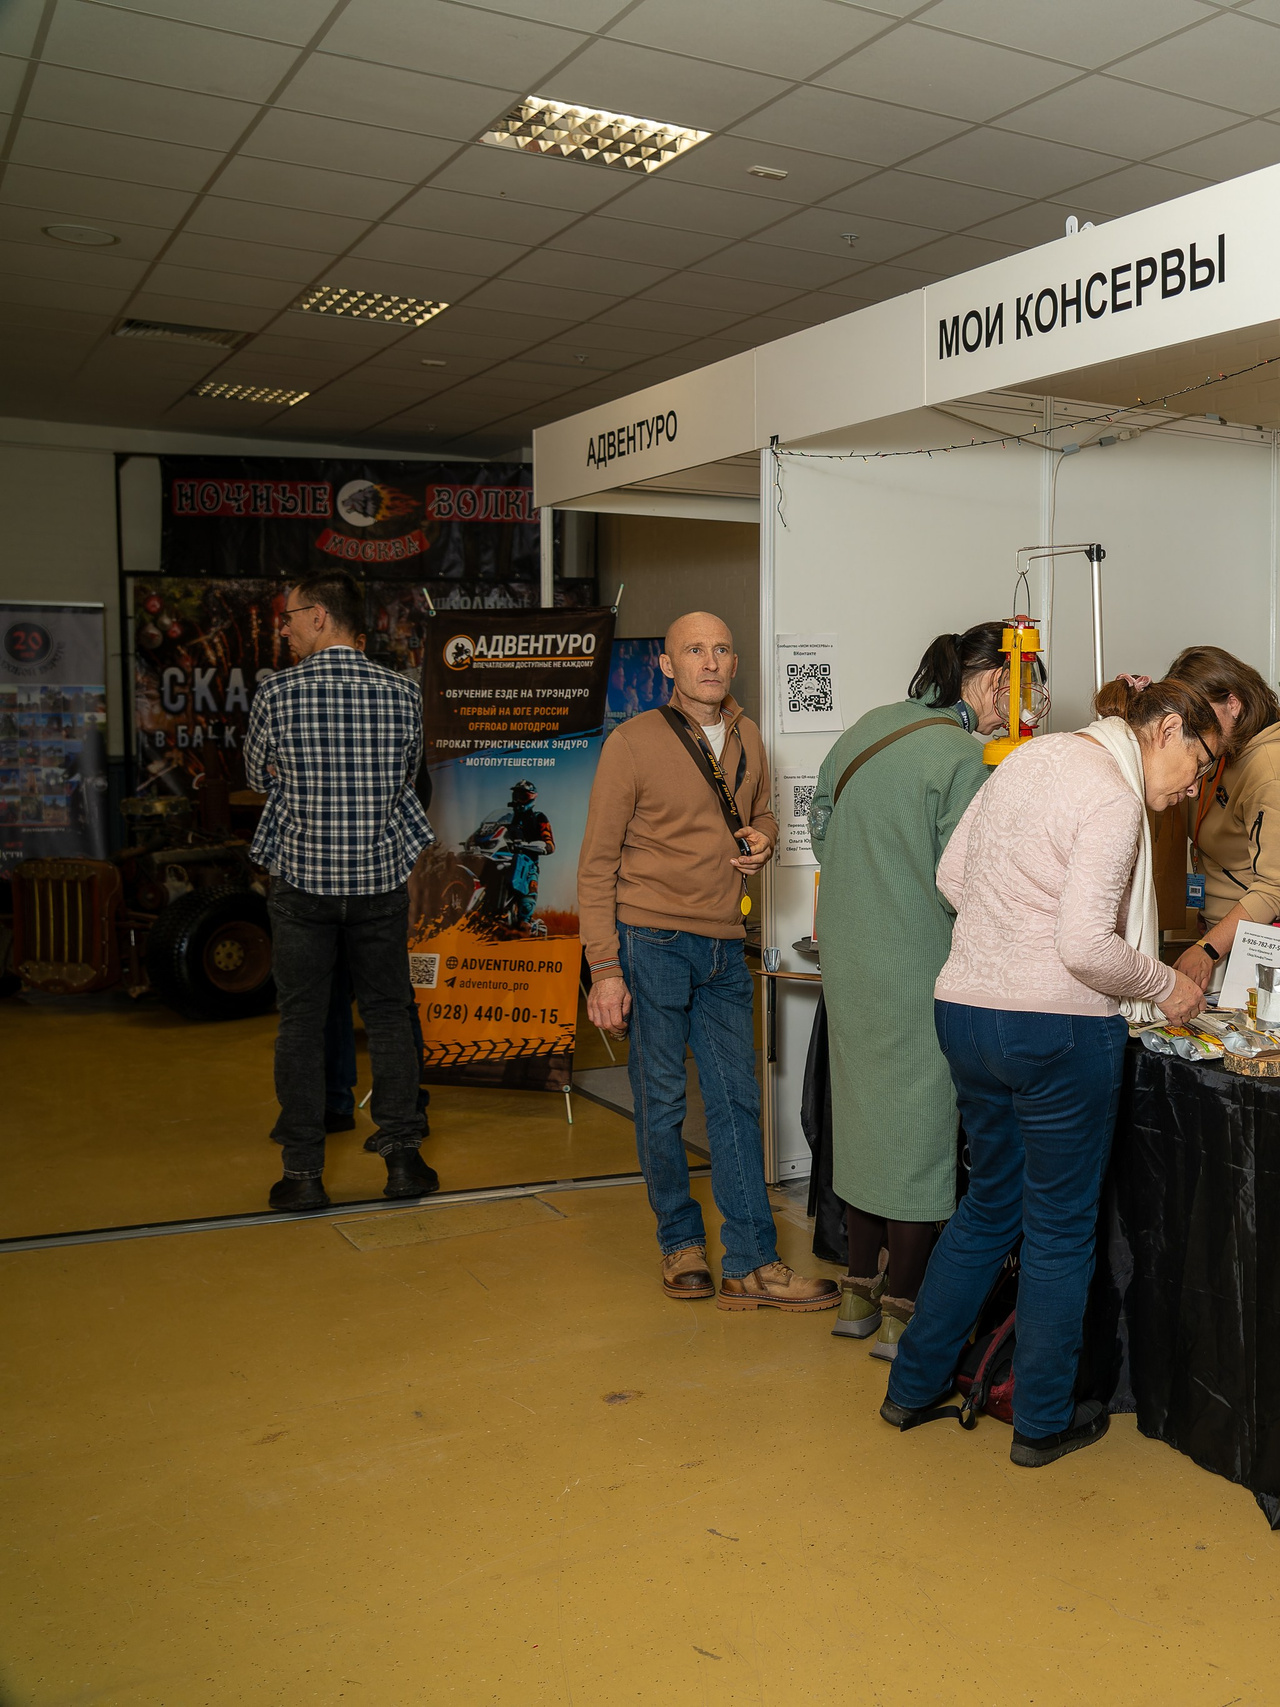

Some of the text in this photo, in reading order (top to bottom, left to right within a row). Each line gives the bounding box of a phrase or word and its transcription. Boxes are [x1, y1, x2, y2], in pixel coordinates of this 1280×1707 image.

[939, 233, 1226, 360] МОИ КОНСЕРВЫ
[587, 410, 678, 470] АДВЕНТУРО
[175, 480, 333, 516] НОЧНЫЕ
[325, 533, 422, 562] МОСКВА
[12, 631, 43, 651] 20
[475, 633, 596, 659] АДВЕНТУРО
[473, 660, 595, 670] ВПЕЧАТЛЕНИЯ ДОСТУПНЫЕ НЕ КАЖДОМУ
[446, 688, 590, 700] ОБУЧЕНИЕ ЕЗДЕ НА ТУРЭНДУРО
[460, 704, 570, 716] ПЕРВЫЙ НА ЮГЕ РОССИИ
[469, 722, 559, 733] OFFROAD МОТОДРОМ
[436, 740, 589, 750] ПРОКАТ ТУРИСТИЧЕСКИХ ЭНДУРО
[466, 758, 555, 767] МОТОПУТЕШЕСТВИЯ
[461, 958, 563, 973] ADVENTURO.PRO
[459, 978, 529, 992] adventuro_pro
[427, 1002, 559, 1025] (928) 440-00-15
